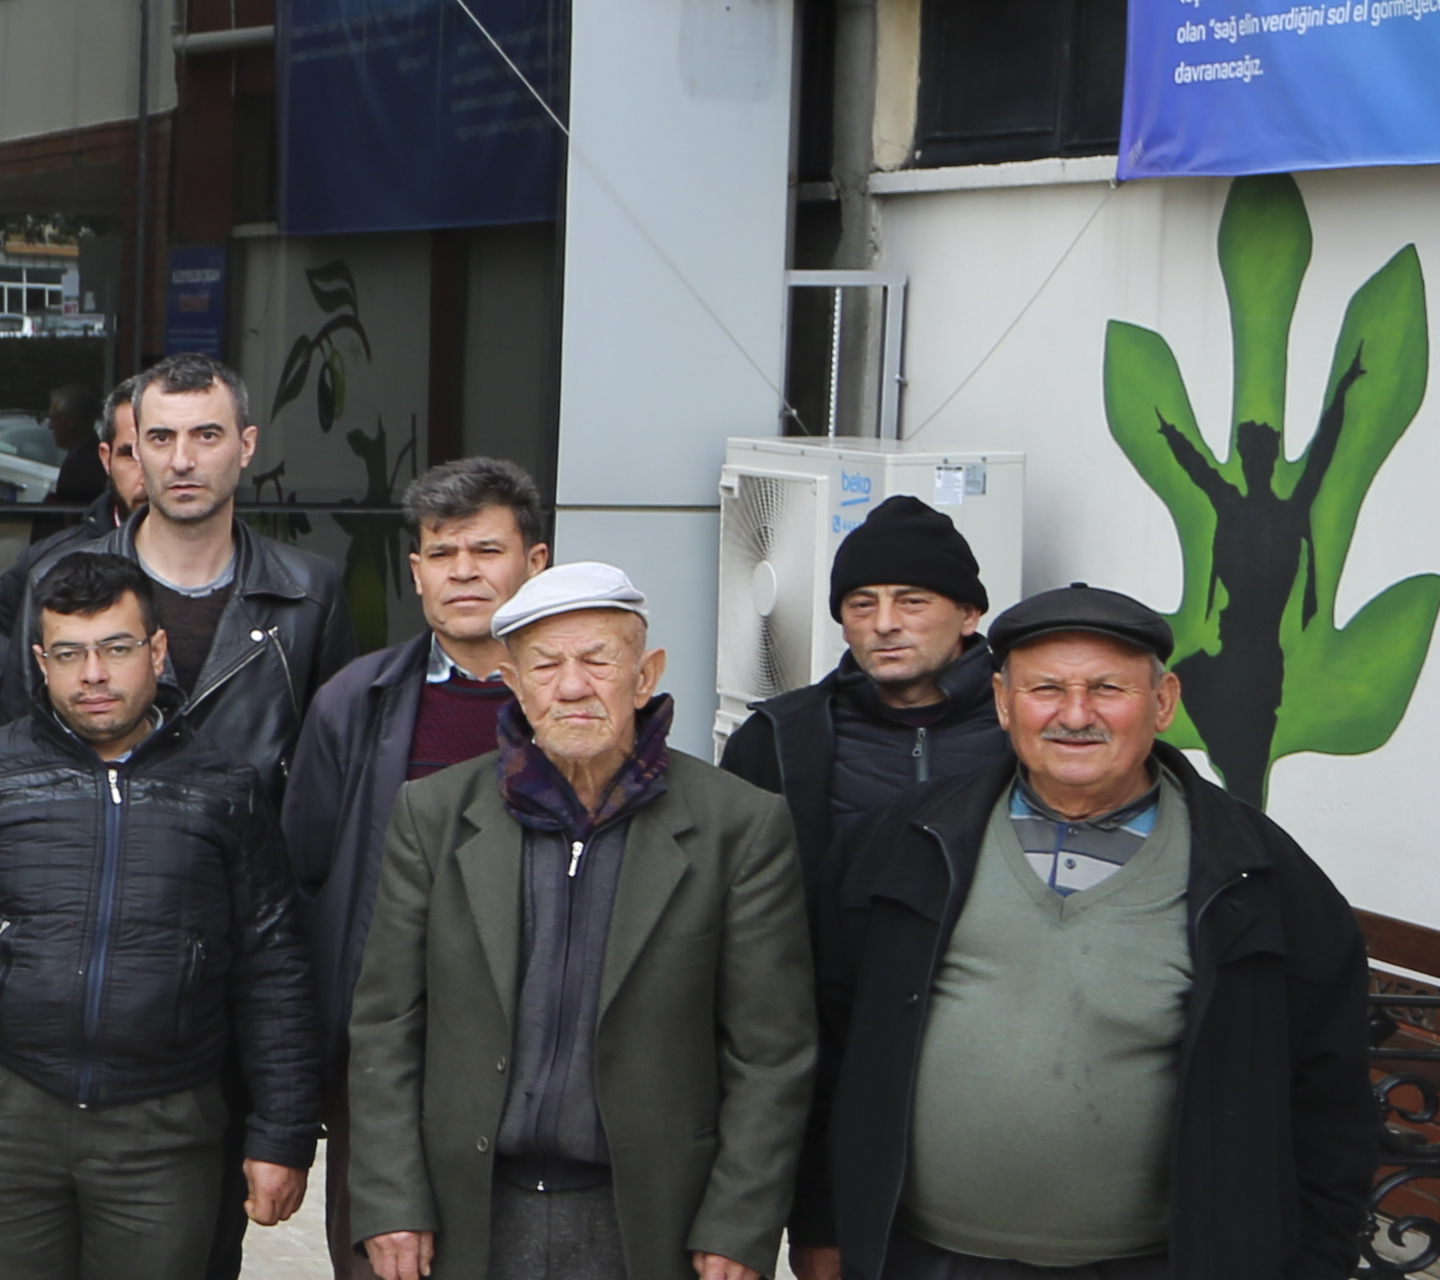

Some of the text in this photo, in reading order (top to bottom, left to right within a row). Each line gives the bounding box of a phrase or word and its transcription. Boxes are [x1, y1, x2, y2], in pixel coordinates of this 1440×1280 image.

[1176, 21, 1207, 45] olan
[1239, 13, 1261, 37] elin
[1262, 4, 1325, 35] verdiğini
[1326, 0, 1352, 26] sol
[1174, 55, 1264, 84] davranacağız.
[841, 470, 872, 494] beko
